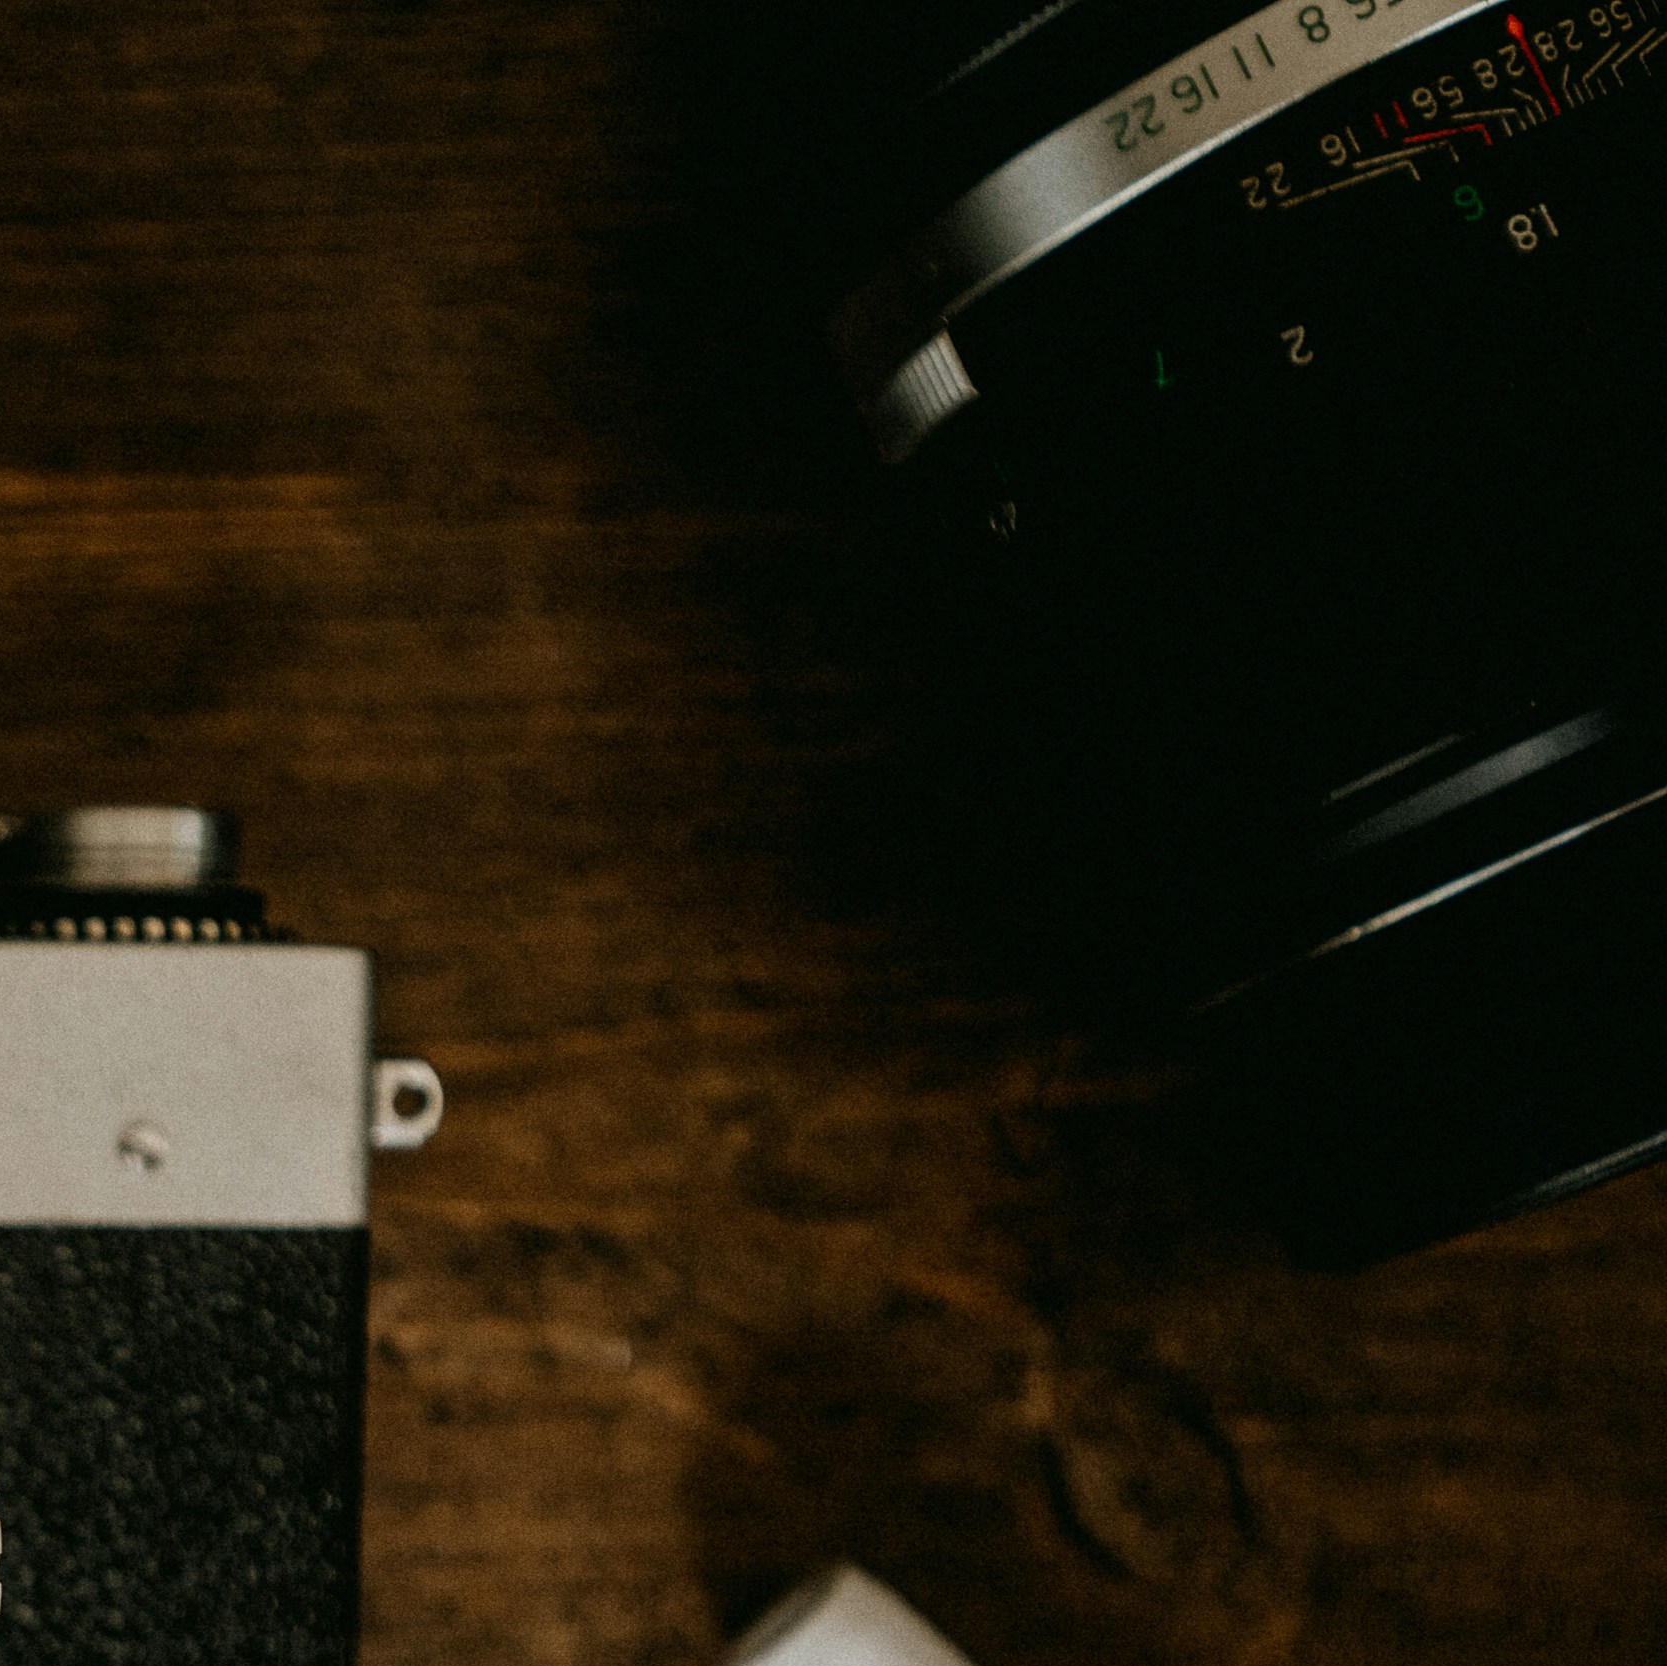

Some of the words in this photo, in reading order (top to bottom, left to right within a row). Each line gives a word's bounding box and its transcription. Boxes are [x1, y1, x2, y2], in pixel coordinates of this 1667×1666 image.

[1298, 4, 1330, 43] 8
[1170, 63, 1220, 115] 16
[1105, 92, 1165, 152] 22
[1319, 125, 1362, 168] 16
[1240, 161, 1292, 210] 22
[1452, 184, 1485, 222] 6
[1280, 324, 1314, 365] 2
